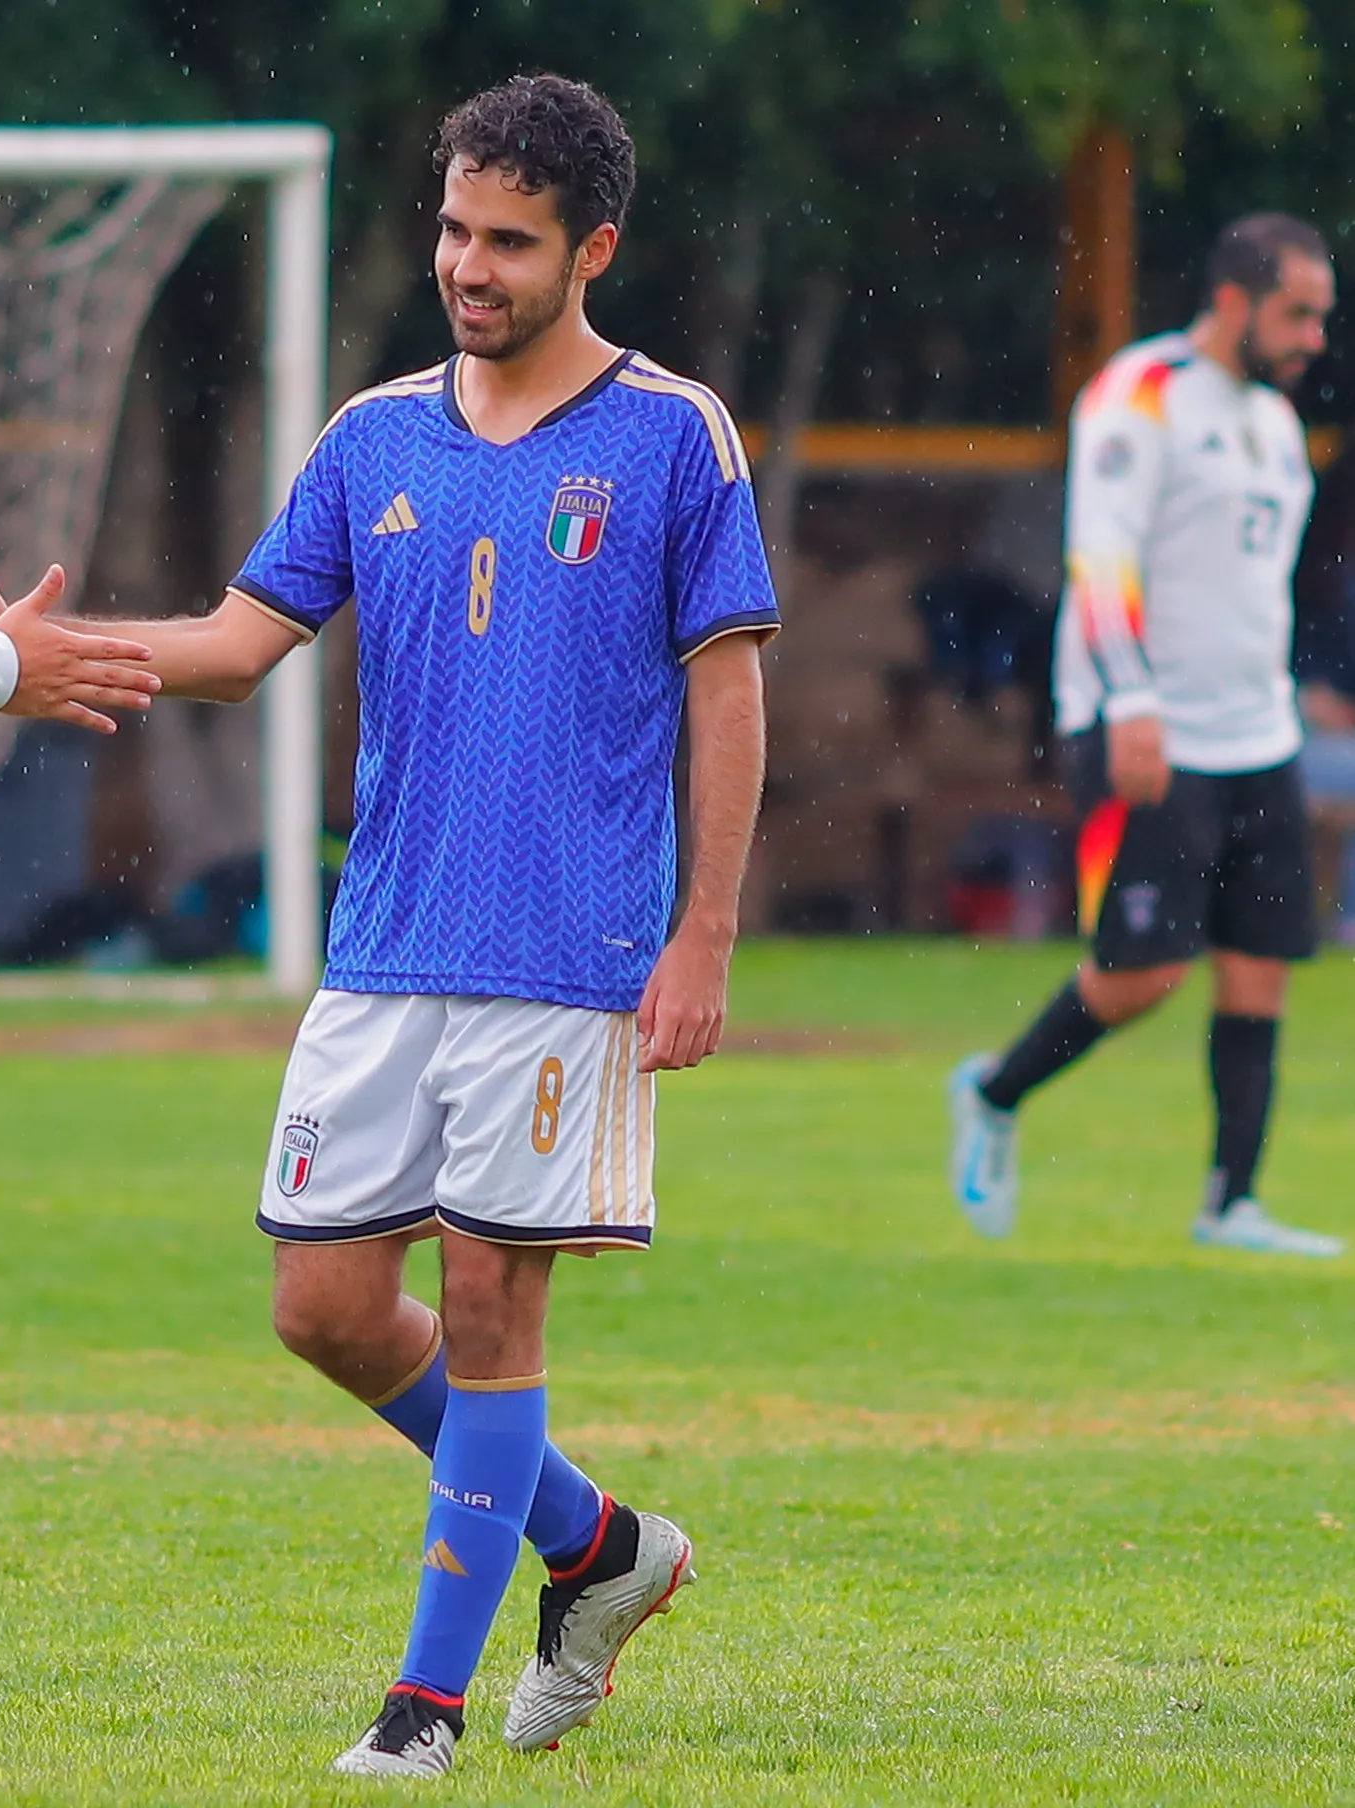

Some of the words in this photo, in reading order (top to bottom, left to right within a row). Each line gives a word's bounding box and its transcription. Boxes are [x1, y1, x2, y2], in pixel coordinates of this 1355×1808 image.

[559, 494, 602, 513] ITALIA
[467, 537, 496, 636] 8
[531, 1056, 564, 1154] 8
[285, 1131, 312, 1152] ITALIA
